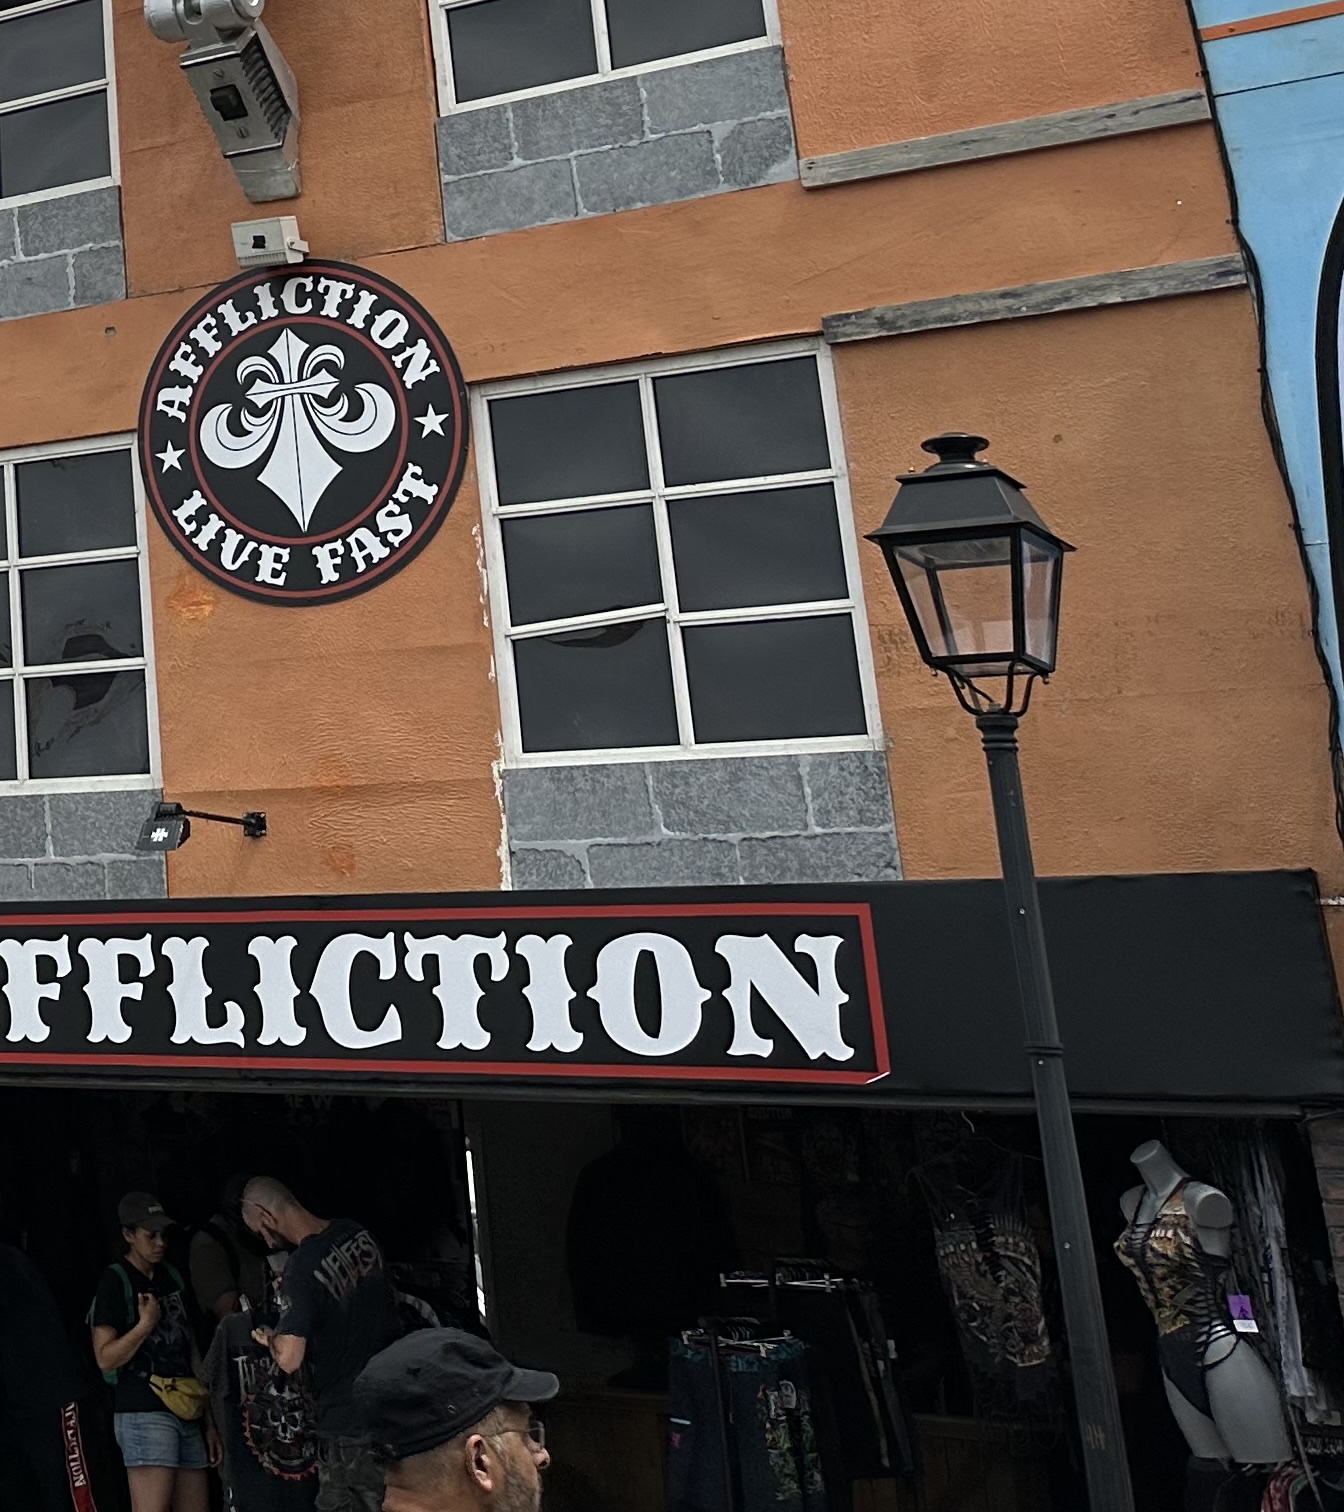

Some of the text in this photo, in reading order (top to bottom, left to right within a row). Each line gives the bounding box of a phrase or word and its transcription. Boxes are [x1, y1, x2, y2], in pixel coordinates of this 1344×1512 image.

[156, 276, 441, 423] AFFLICTION
[172, 462, 439, 587] LIVE FAST
